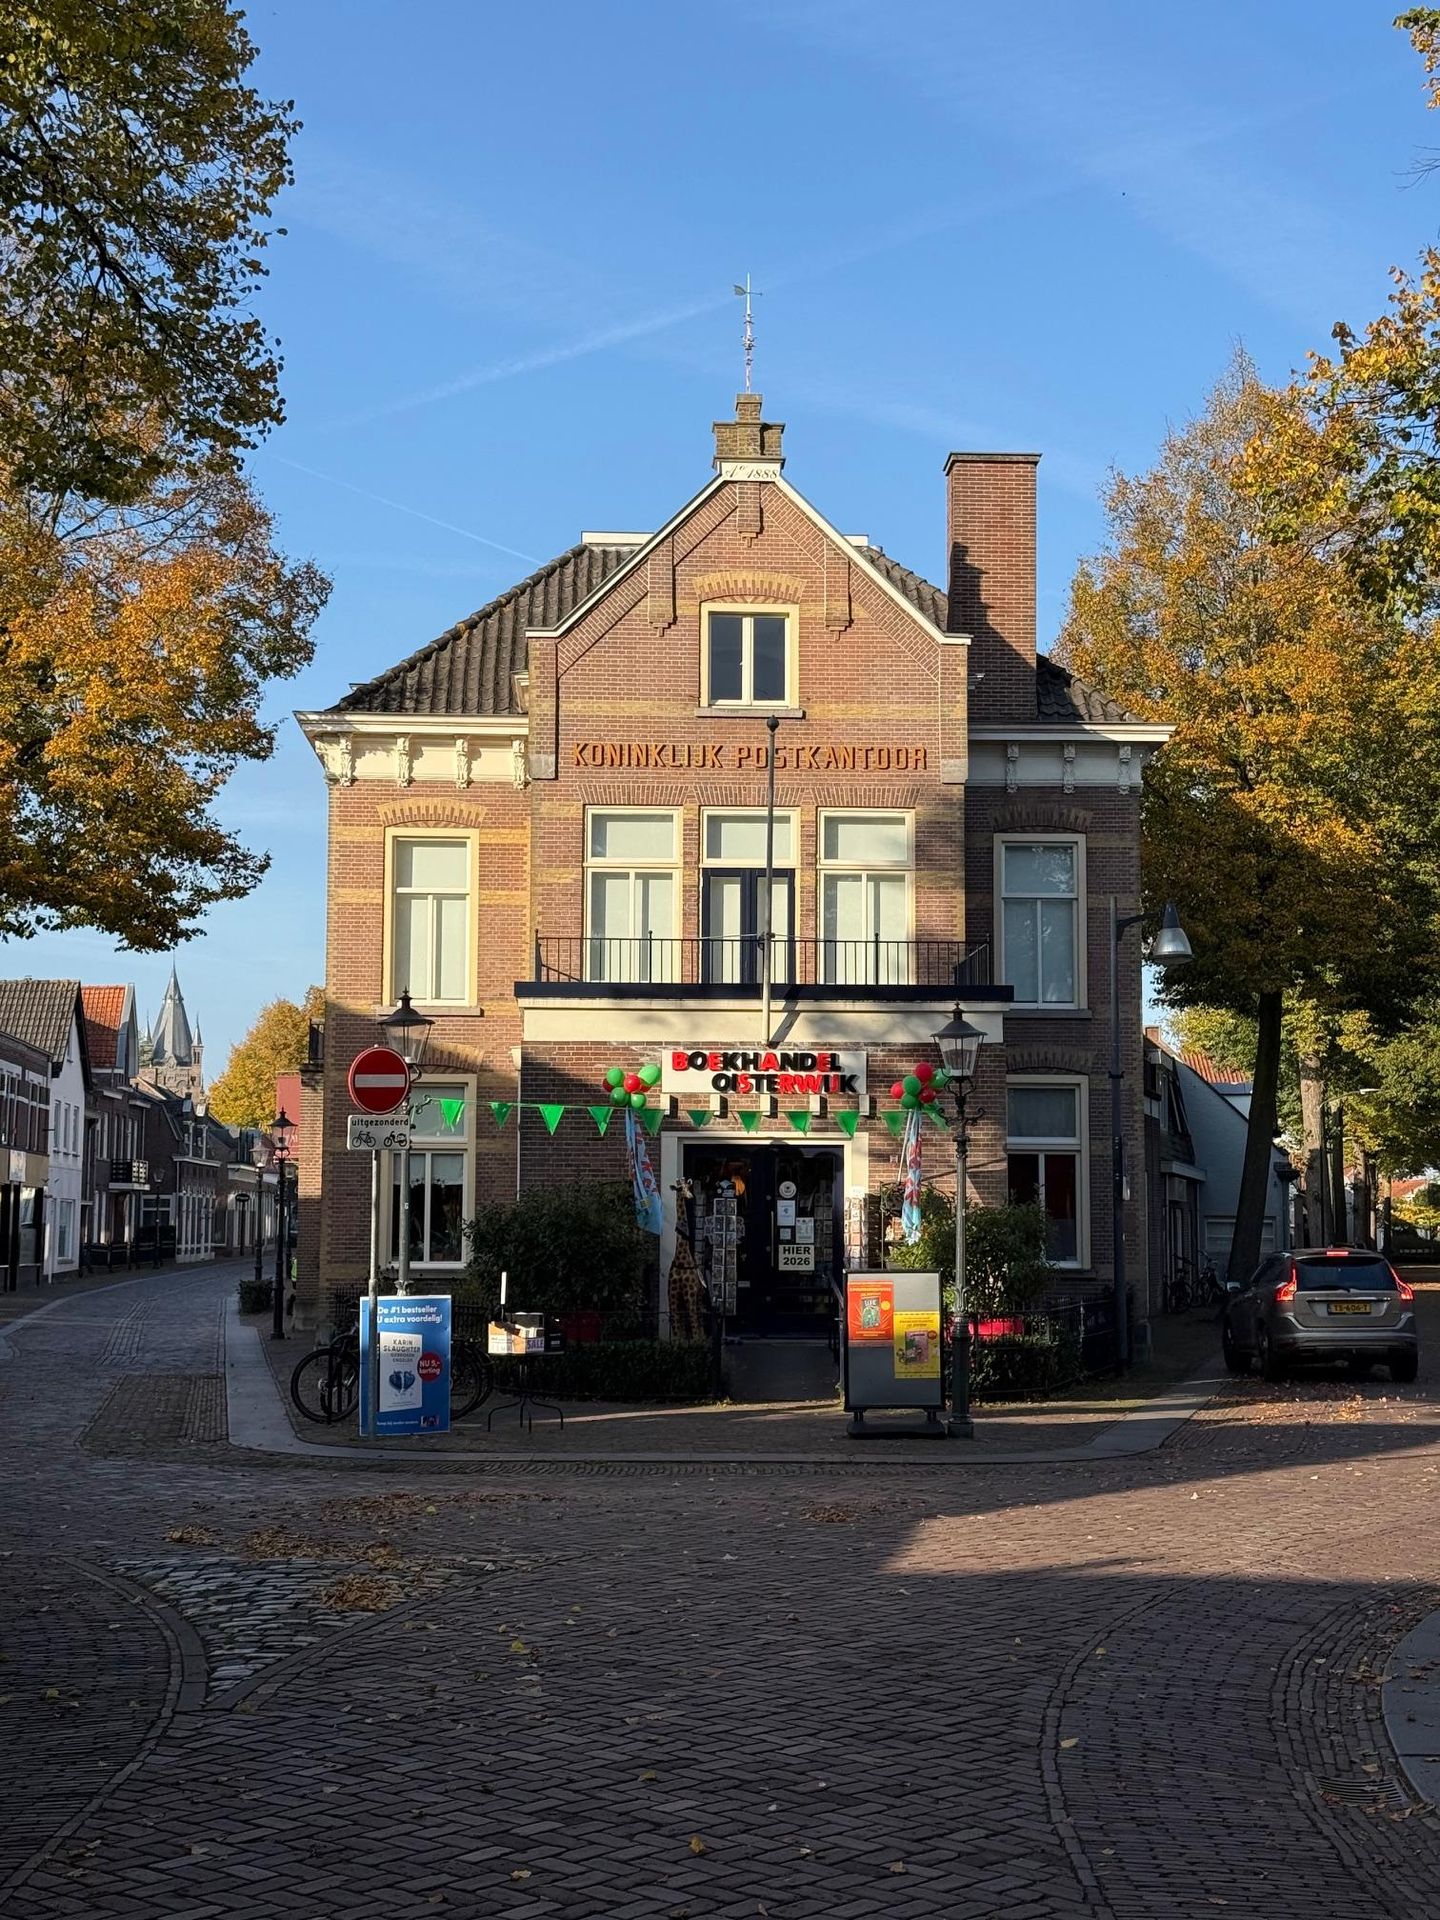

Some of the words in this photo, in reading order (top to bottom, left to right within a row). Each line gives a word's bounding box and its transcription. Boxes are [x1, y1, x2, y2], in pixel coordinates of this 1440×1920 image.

[746, 468, 779, 479] 1888
[572, 742, 724, 768] KONINKLIJK
[735, 745, 927, 771] POSTKANTOOR
[671, 1051, 842, 1072] BOEKHANDEL
[711, 1072, 858, 1094] OISTERWIJK
[352, 1118, 409, 1128] uitgezonderd
[783, 1246, 811, 1255] HIER
[783, 1257, 811, 1266] 2026
[377, 1306, 389, 1314] De
[390, 1306, 400, 1314] #1
[401, 1305, 437, 1314] bestseller
[384, 1316, 405, 1324] extra
[407, 1314, 443, 1324] voordelig!
